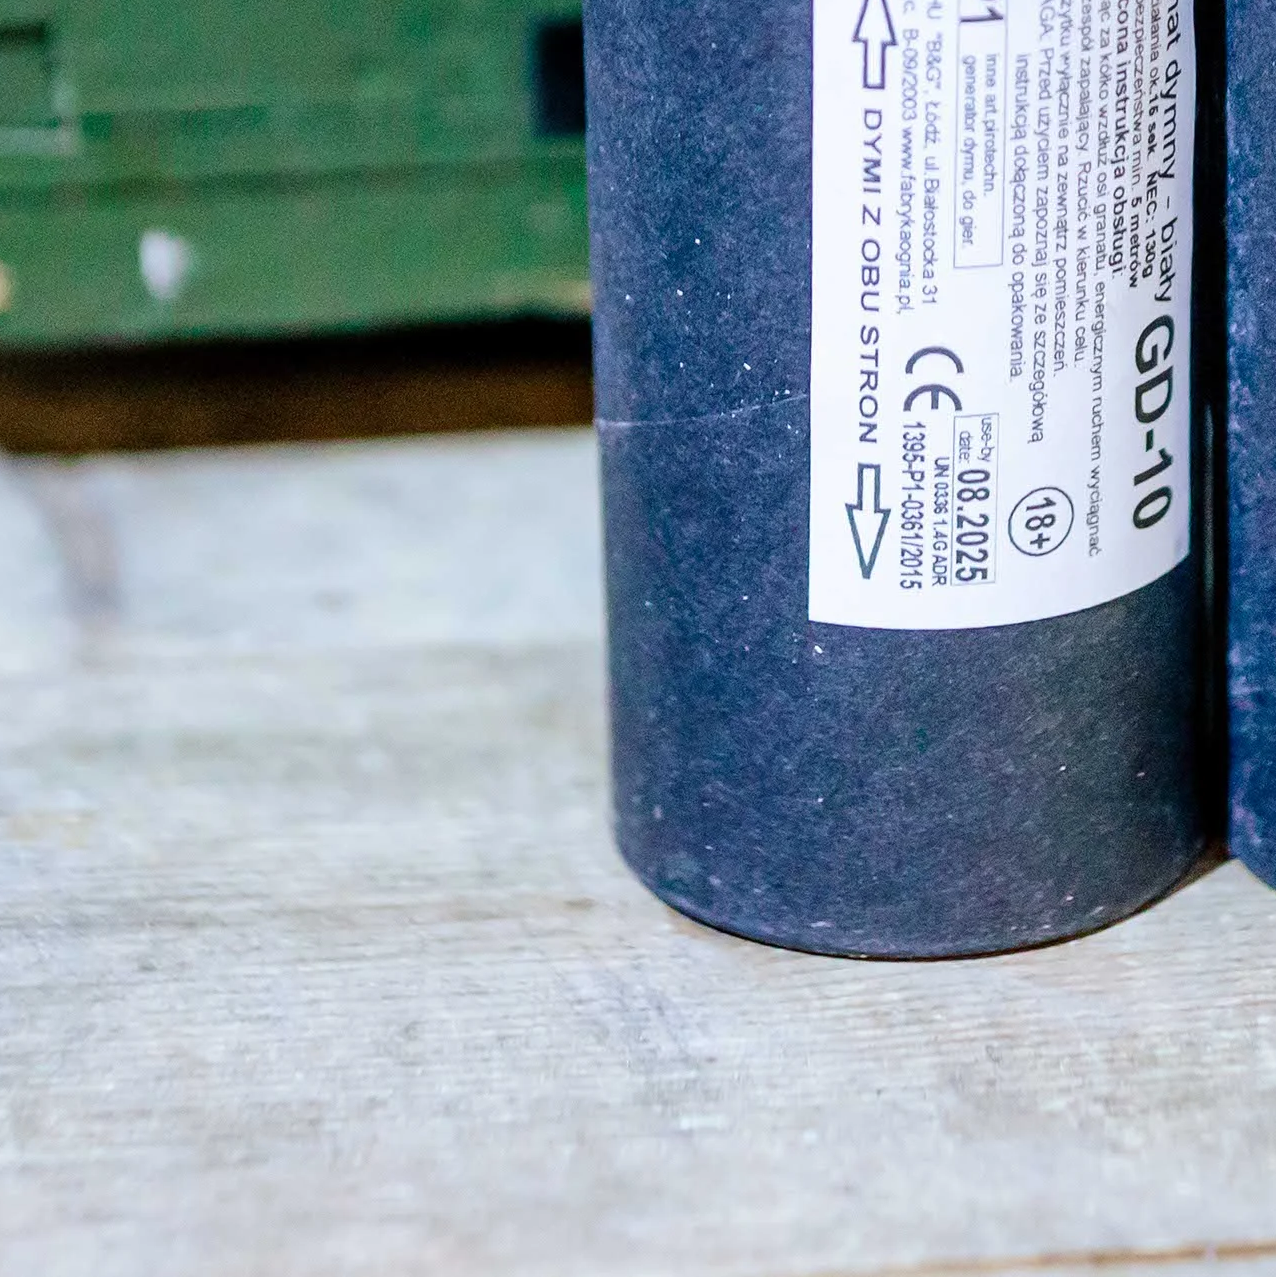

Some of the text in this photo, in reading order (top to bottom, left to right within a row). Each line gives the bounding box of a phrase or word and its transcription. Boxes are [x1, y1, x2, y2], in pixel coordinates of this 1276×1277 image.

[1099, 28, 1110, 48] za
[901, 28, 920, 121] B-09/2003
[962, 55, 977, 133] generator
[985, 54, 1001, 88] inne
[1038, 48, 1055, 101] Przed
[1056, 51, 1073, 139] wyłącznie
[1098, 53, 1112, 100] kółko
[1110, 61, 1131, 179] instrukcja
[1158, 59, 1181, 179] dymny
[960, 137, 979, 186] dymu,
[1057, 145, 1070, 167] na
[962, 190, 977, 210] do
[1096, 172, 1110, 197] osi
[1131, 196, 1143, 208] 5
[1007, 53, 1032, 382] instrukcją dołączoną do opakowania.
[1031, 187, 1050, 267] zapoznaj
[1053, 173, 1069, 252] zewnątrz
[1077, 225, 1088, 240] w
[858, 108, 883, 444] DYMI Z OBU STRON
[1129, 214, 1142, 288] metrów
[1142, 229, 1157, 279] 130g
[1155, 217, 1178, 302] biały
[922, 284, 938, 305] 31
[1031, 272, 1050, 298] się
[1075, 246, 1090, 321] kierunku
[1034, 304, 1048, 325] ze
[1091, 281, 1106, 392] energicznym
[1074, 326, 1088, 368] celu.
[977, 417, 996, 463] use-by
[1090, 397, 1105, 461] ruchem
[1133, 315, 1174, 530] GD-10
[933, 456, 950, 478] UN
[899, 421, 926, 590] 1395-P1-0361/2015
[932, 481, 950, 514] 0336
[1024, 496, 1057, 550] 18+
[954, 468, 991, 583] 08.2025
[931, 554, 948, 587] ADR
